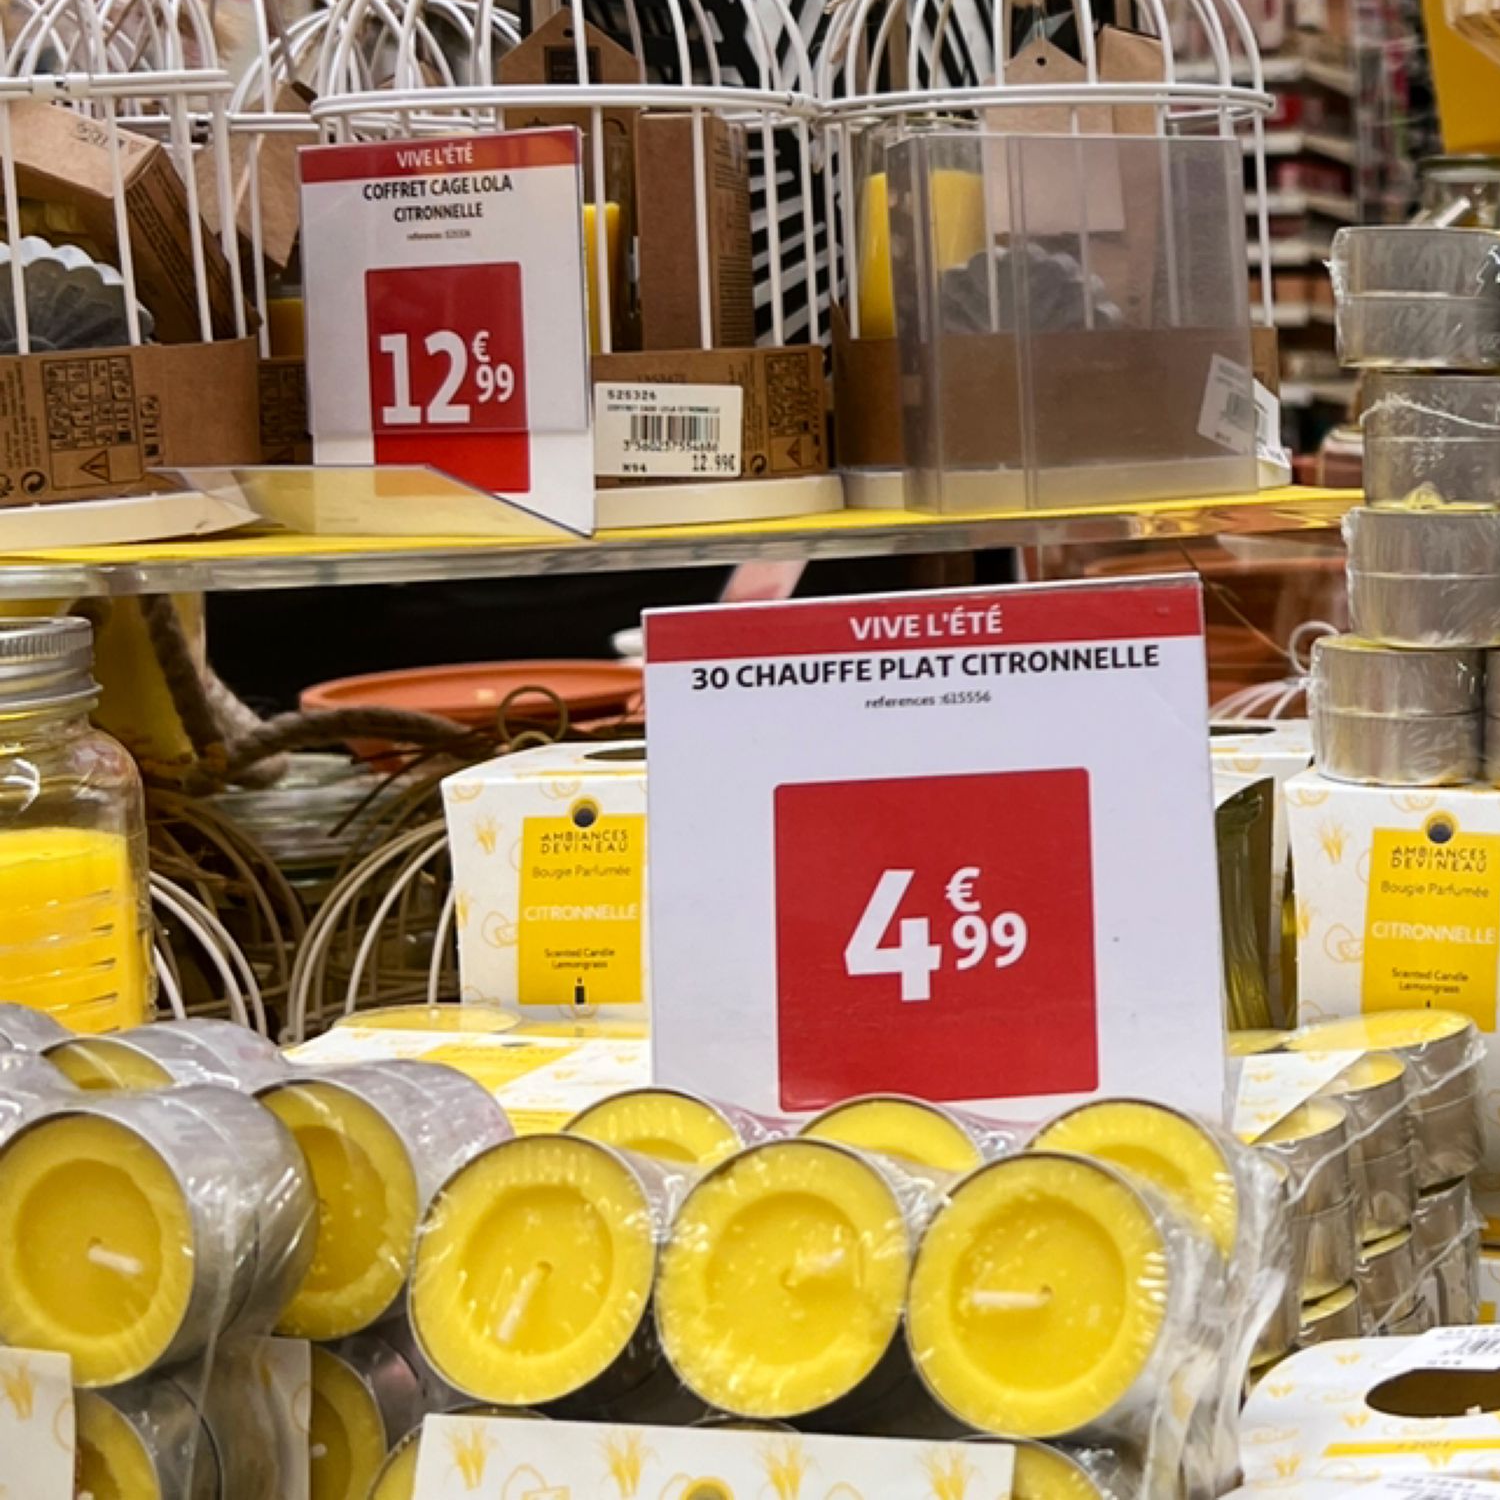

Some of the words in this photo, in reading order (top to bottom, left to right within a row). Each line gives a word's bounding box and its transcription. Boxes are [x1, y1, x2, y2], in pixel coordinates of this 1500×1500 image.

[397, 149, 431, 168] VIVE
[435, 141, 474, 165] L'ÉTÉ
[363, 180, 426, 200] COFFRET
[430, 177, 470, 196] CAGE
[474, 175, 513, 192] LOLA
[394, 202, 483, 222] CITRONNELLE
[850, 615, 921, 640] VIVE
[927, 605, 1003, 636] L'ÉTÉ
[692, 667, 729, 690] 30
[736, 658, 872, 688] CHAUFFE
[880, 654, 954, 680] PLAT
[961, 645, 1160, 676] CITRONNELLE
[865, 694, 935, 708] references
[541, 829, 628, 842] AMBIANCES
[541, 842, 629, 854] DEVINEAU
[1392, 846, 1487, 861] AMBIANCES
[1391, 857, 1487, 873] DEVINEAU
[1381, 880, 1425, 896] Bougie
[525, 903, 638, 921] CITRONNELLE
[1371, 921, 1496, 945] CITRONNELLE
